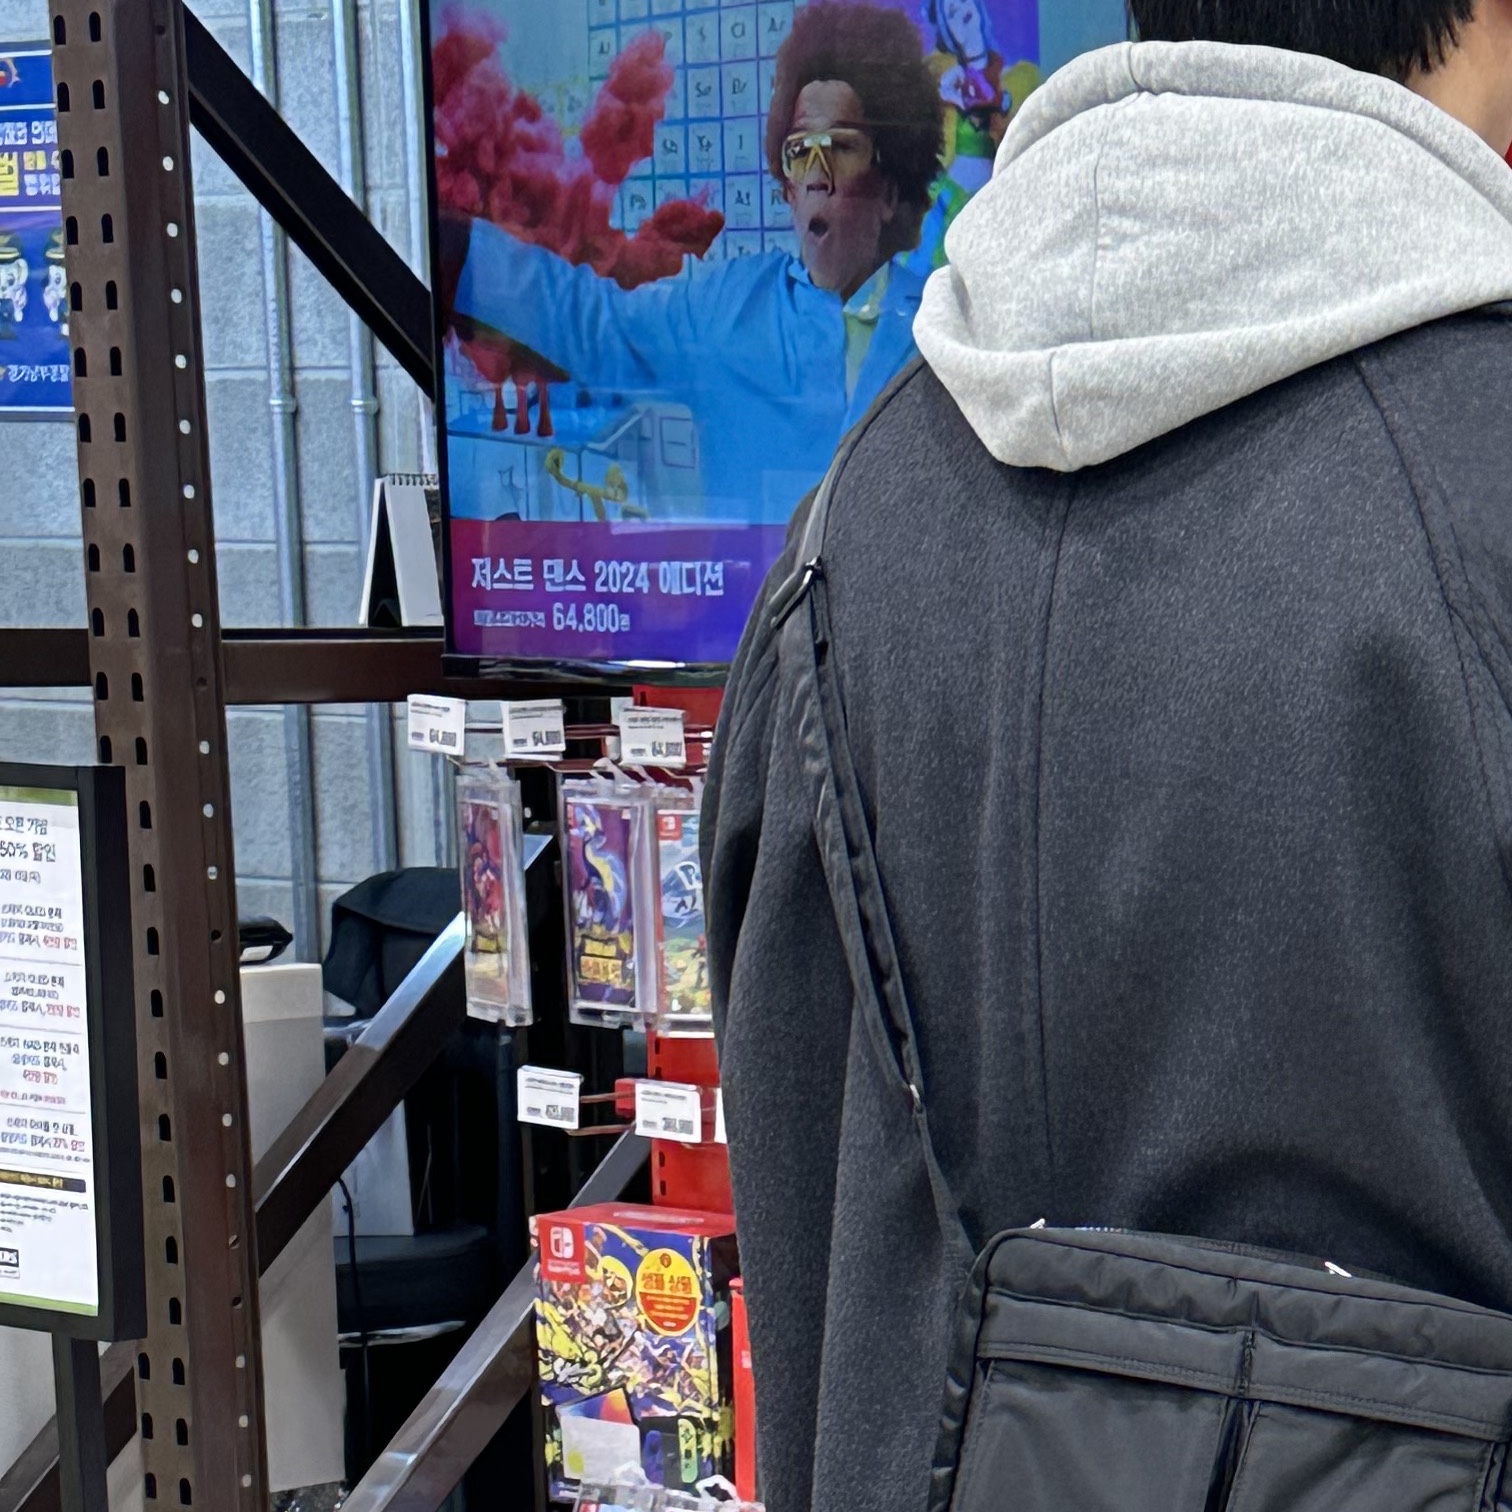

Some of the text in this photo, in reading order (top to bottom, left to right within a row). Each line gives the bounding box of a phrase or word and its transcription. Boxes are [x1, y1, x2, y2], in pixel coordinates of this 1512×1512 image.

[471, 556, 725, 596] 저스트 댄스 2024 에디션
